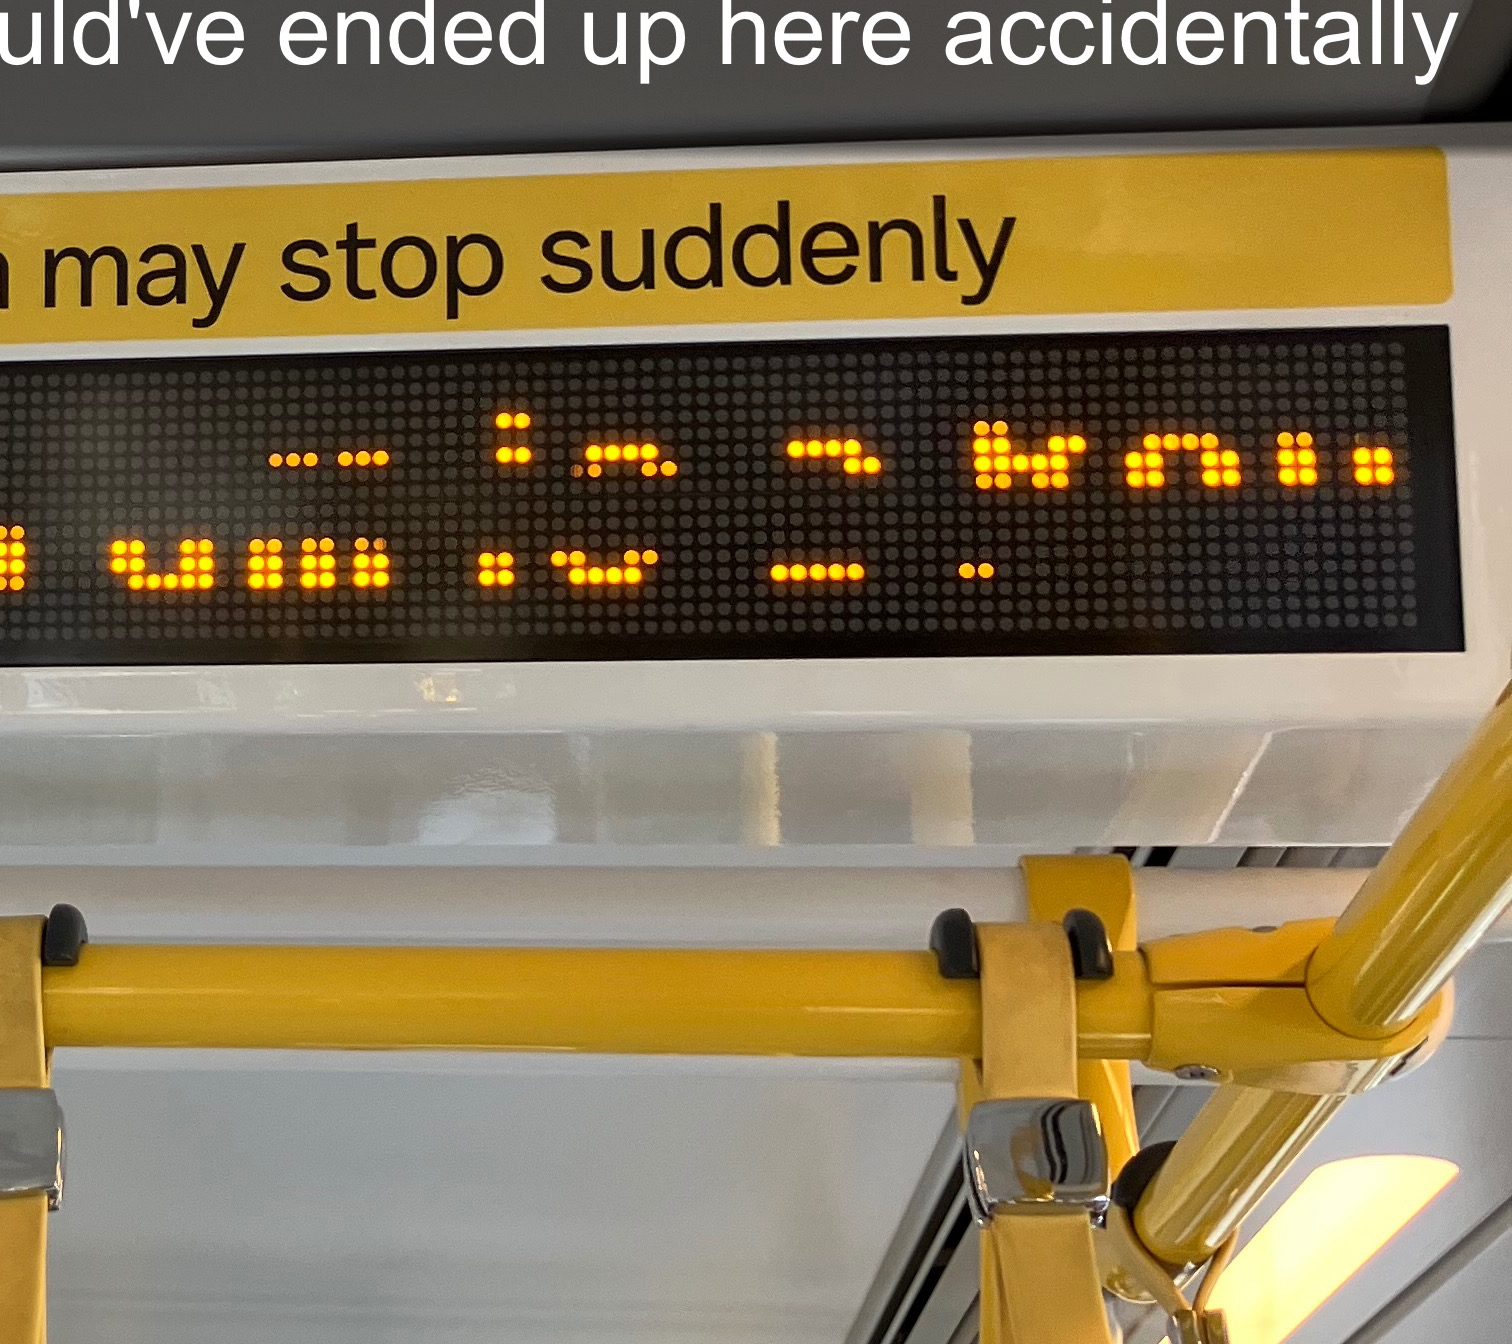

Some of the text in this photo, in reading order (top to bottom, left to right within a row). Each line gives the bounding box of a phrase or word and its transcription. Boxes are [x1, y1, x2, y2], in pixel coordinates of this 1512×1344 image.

[43, 240, 246, 329] may
[280, 221, 505, 320] stop
[540, 194, 1017, 306] suddenly
